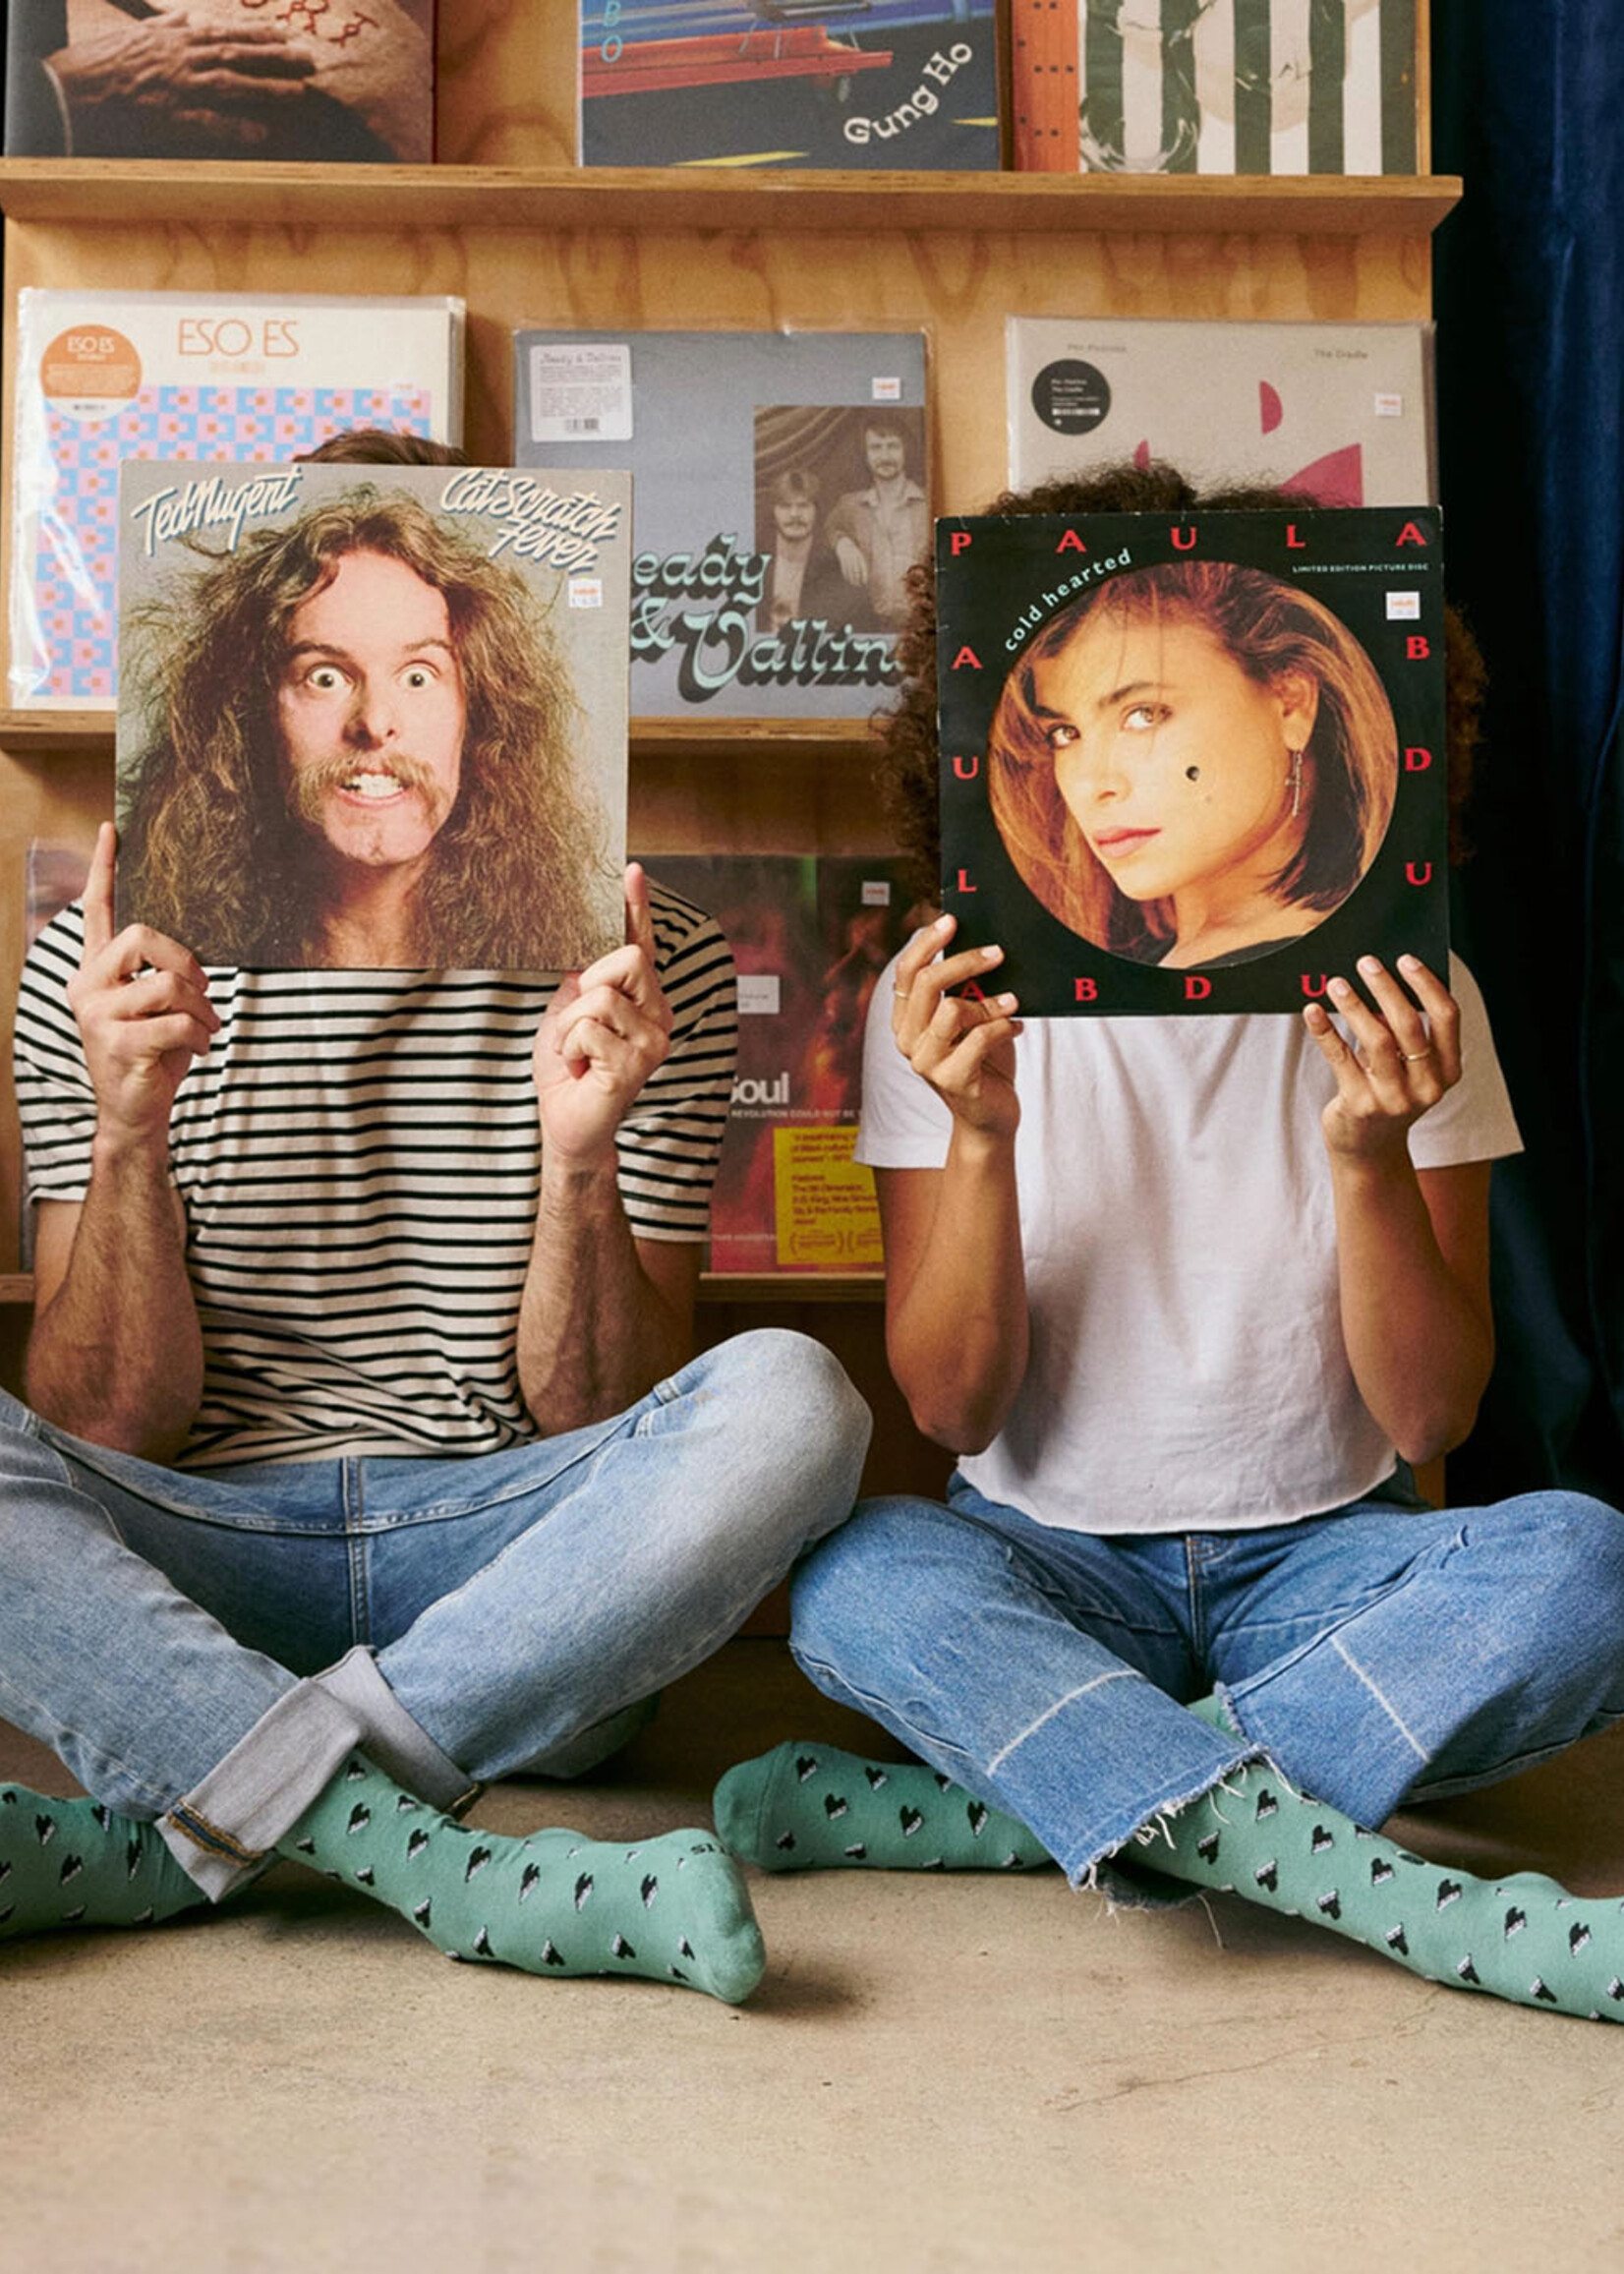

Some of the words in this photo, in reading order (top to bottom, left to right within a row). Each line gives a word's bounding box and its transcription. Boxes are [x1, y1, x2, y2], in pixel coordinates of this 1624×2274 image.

[843, 85, 939, 144] Gung
[922, 43, 972, 86] Ho
[178, 319, 253, 356] ESO
[262, 321, 299, 358] ES
[440, 466, 511, 514] Cat
[490, 475, 622, 545] Scratch
[489, 515, 600, 576] Fever
[1005, 605, 1043, 651] cold
[1042, 548, 1131, 607] hearted
